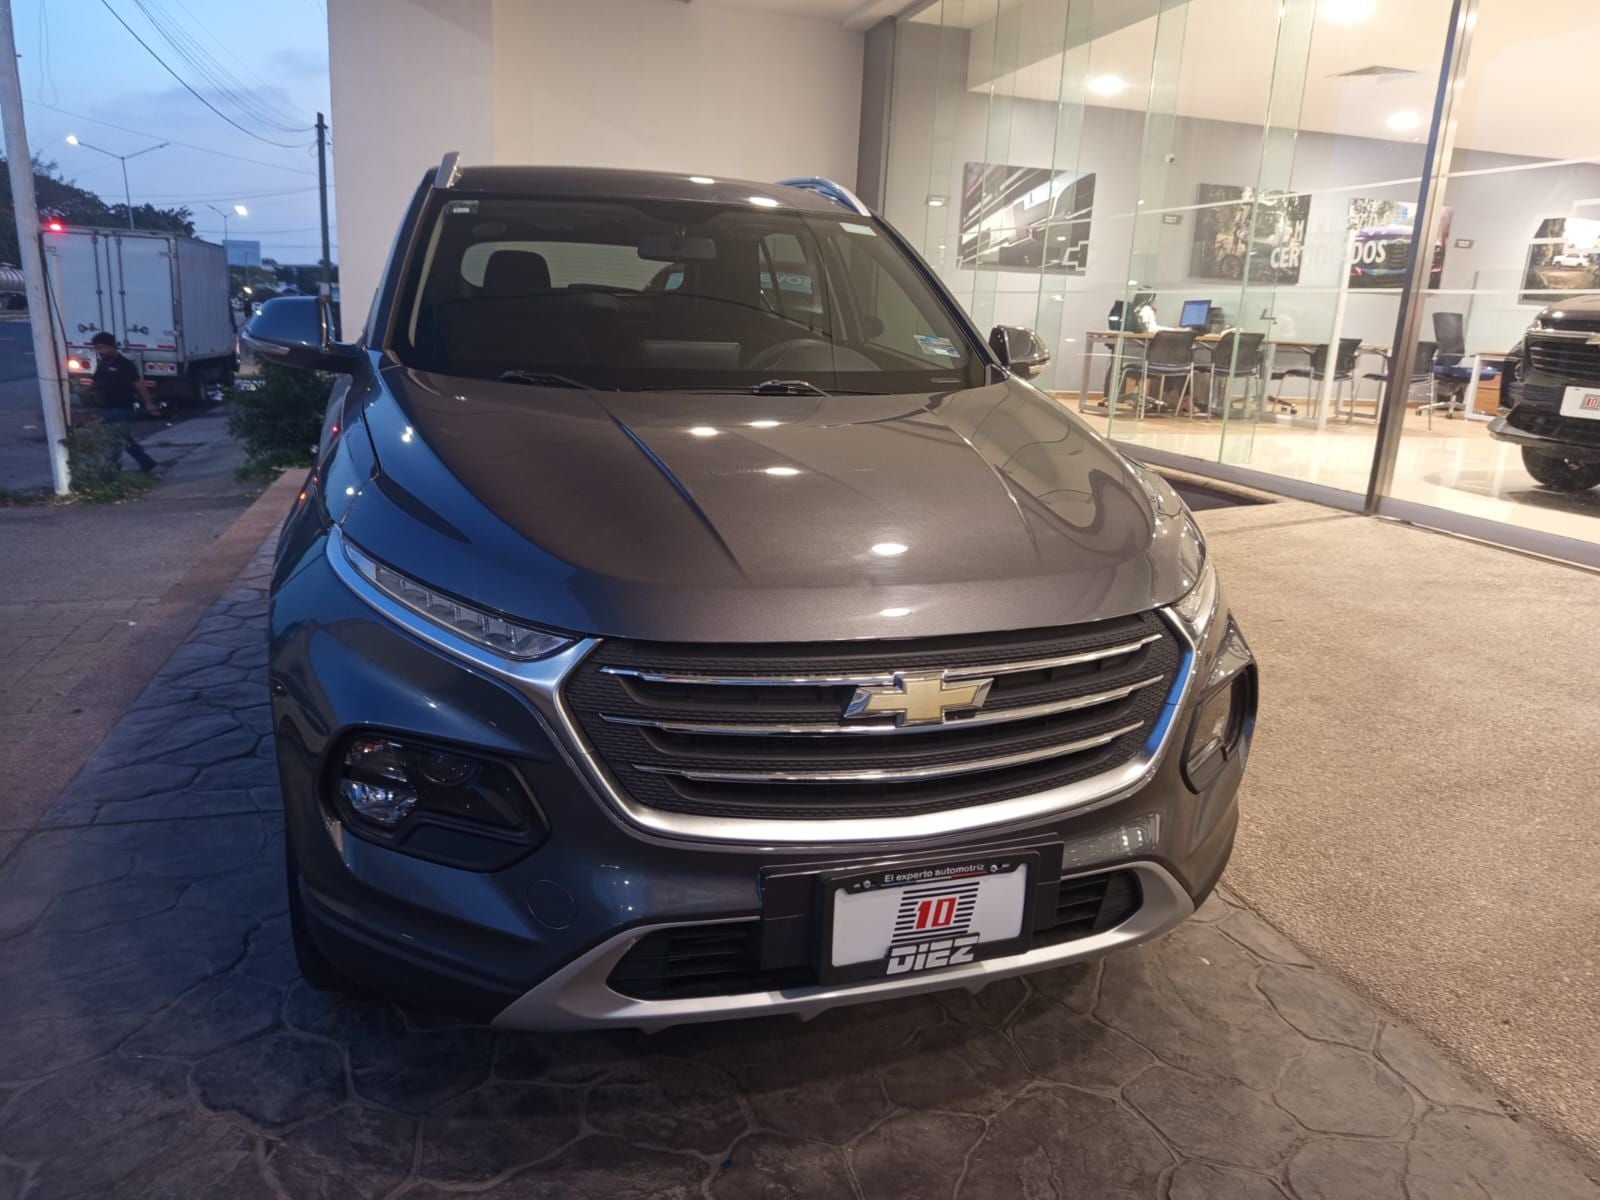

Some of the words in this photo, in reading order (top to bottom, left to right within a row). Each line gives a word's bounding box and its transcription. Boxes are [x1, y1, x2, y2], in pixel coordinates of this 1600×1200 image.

[884, 873, 894, 883] El
[896, 868, 933, 882] experto
[934, 863, 985, 877] automotriz
[915, 897, 958, 929] 10
[886, 933, 980, 975] DIEZ
